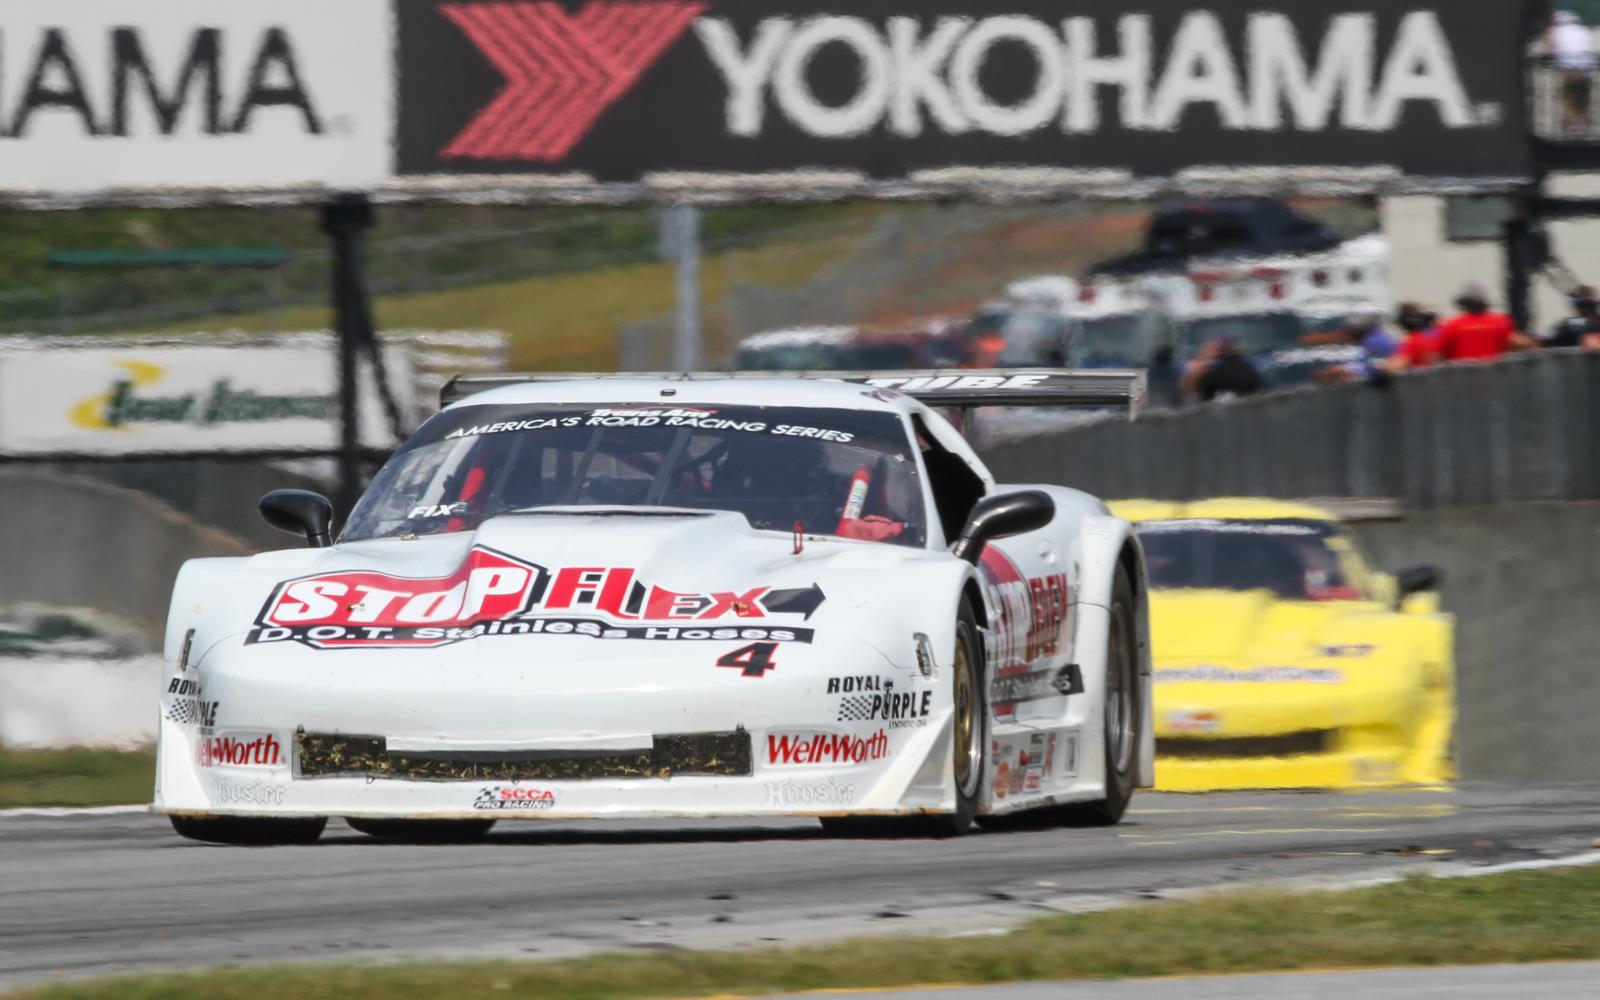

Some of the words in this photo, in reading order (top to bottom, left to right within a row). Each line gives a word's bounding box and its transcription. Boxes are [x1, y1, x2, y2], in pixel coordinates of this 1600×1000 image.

[0, 26, 322, 137] AMA
[693, 11, 1471, 137] YOKOHAMA
[445, 416, 582, 440] AMERICA'S
[585, 416, 660, 427] ROAD
[665, 416, 766, 432] RACING
[771, 424, 854, 442] SERIES
[272, 566, 528, 624] STOP
[257, 626, 394, 642] D.O.T.
[413, 618, 628, 640] Stainless
[644, 627, 796, 642] Hoses
[716, 642, 780, 678] 4
[827, 674, 880, 694] ROYAL
[870, 690, 932, 720] PURPLE
[475, 800, 502, 809] PRO
[500, 787, 555, 801] SCCA
